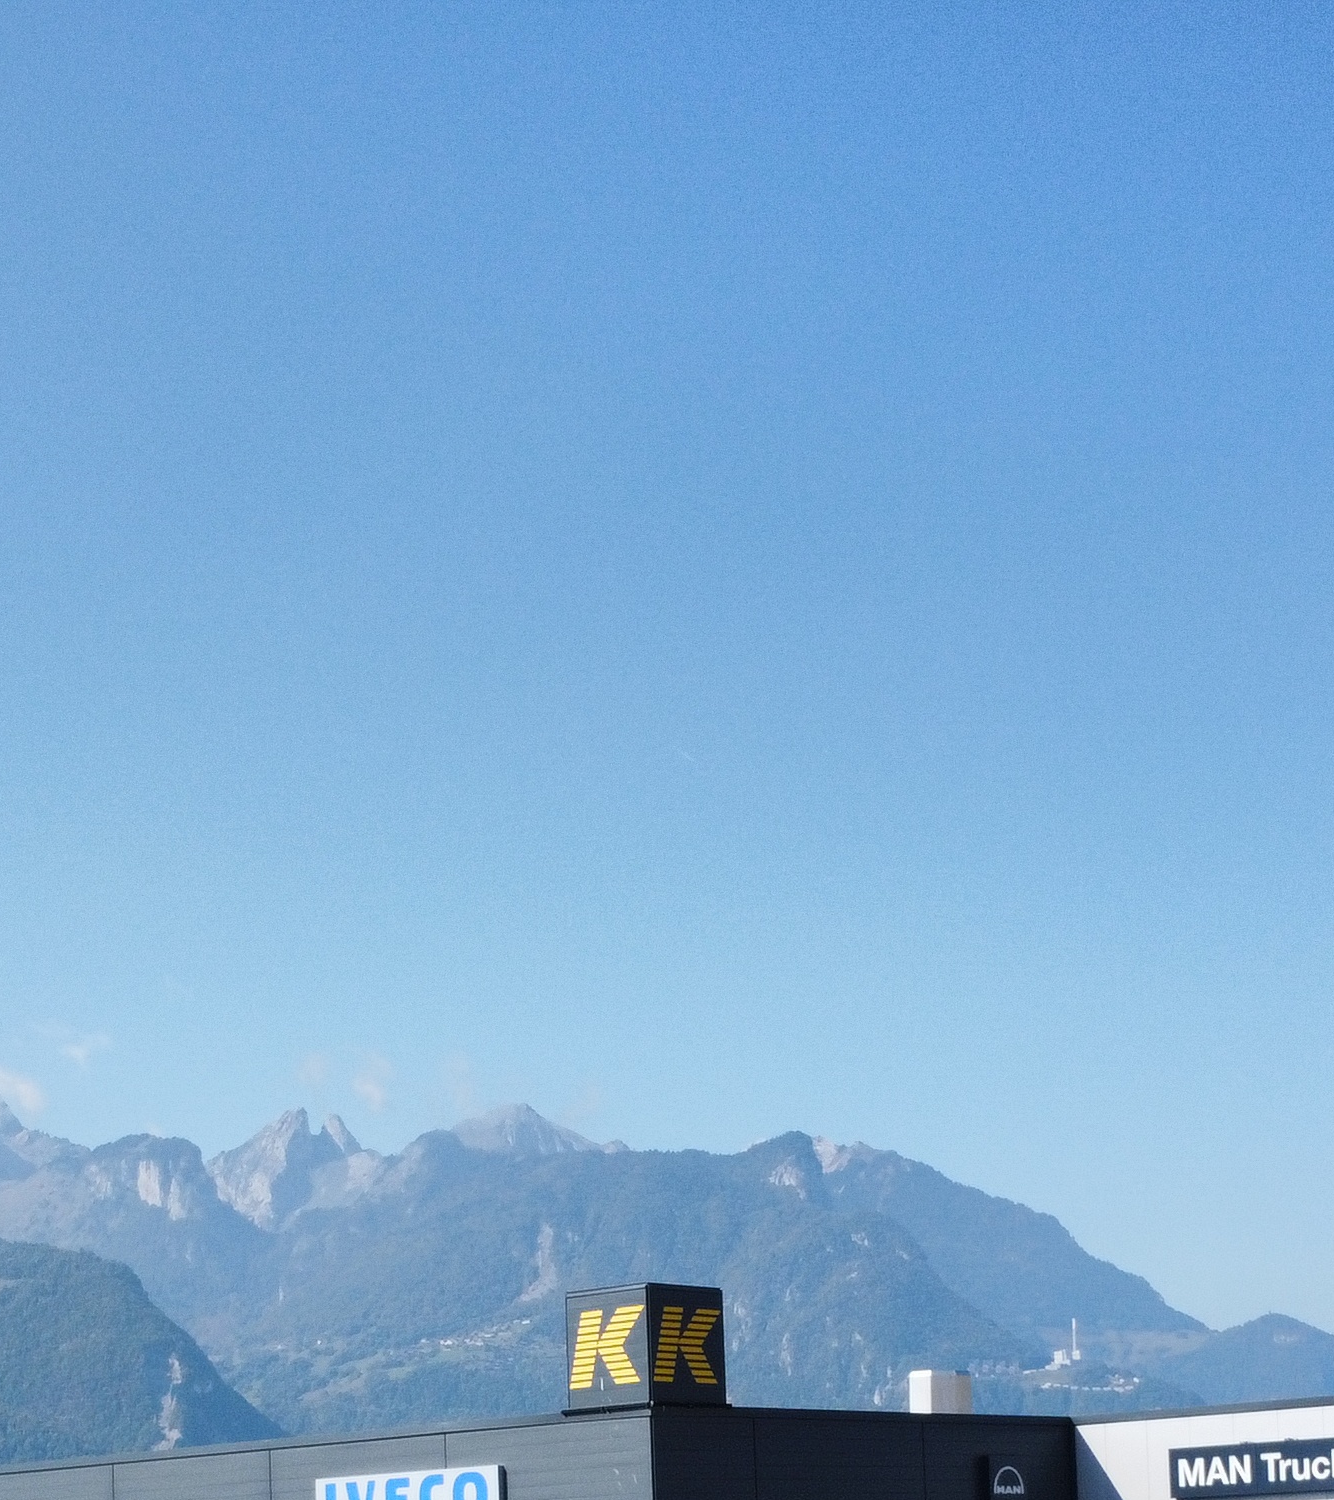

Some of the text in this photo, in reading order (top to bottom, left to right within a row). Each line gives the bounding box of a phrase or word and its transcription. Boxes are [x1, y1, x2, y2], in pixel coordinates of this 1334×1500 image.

[570, 1304, 645, 1390] K
[654, 1306, 721, 1385] K
[996, 1485, 1022, 1495] MAN
[1177, 1454, 1252, 1488] MAN
